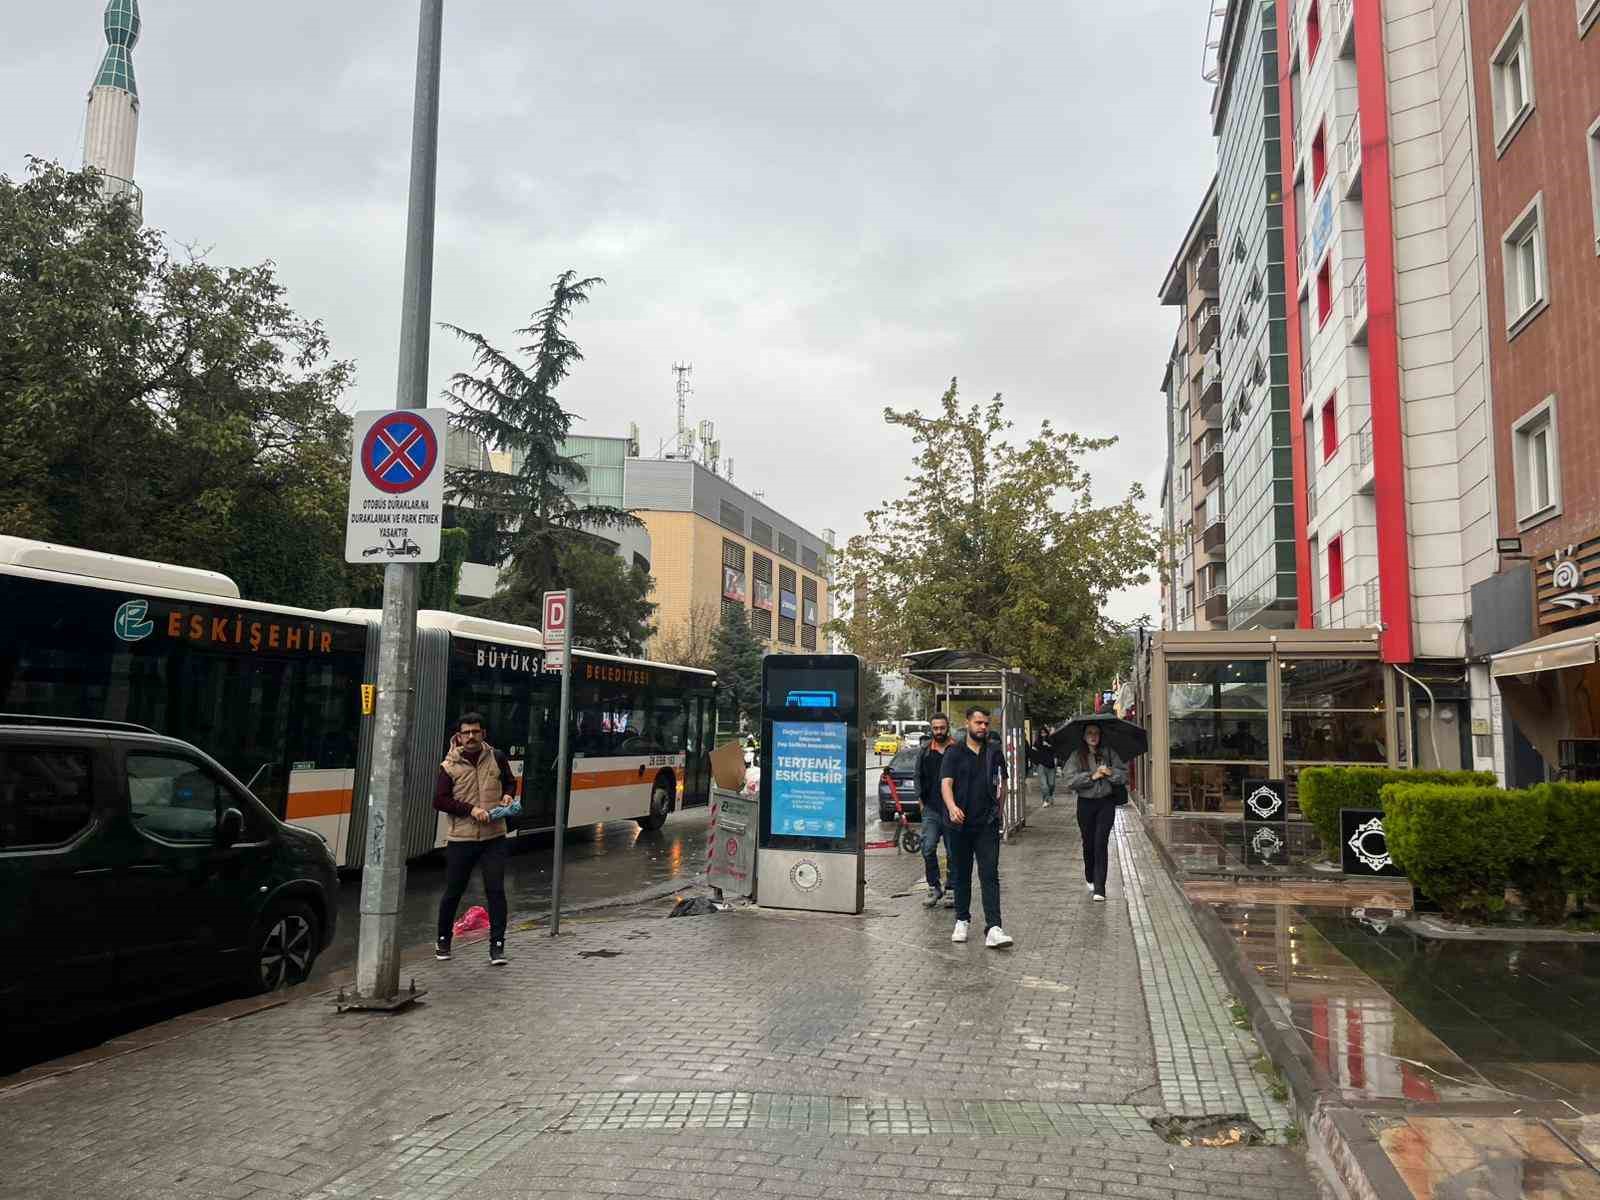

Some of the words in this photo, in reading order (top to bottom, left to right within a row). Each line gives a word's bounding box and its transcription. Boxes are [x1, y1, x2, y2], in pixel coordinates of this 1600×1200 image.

[363, 498, 387, 509] OTOBÜS
[388, 499, 429, 509] DURAKLARNA
[351, 513, 391, 524] DURAKLAMAK
[392, 513, 401, 524] VE
[402, 513, 417, 524] PARK
[419, 514, 439, 524] ETMEK
[379, 528, 408, 538] YASAKTIR
[551, 602, 564, 626] D
[168, 610, 333, 652] ESKİŞEHİR
[777, 756, 842, 769] TERTEMİZ
[775, 768, 843, 784] ESKİŞEHİR
